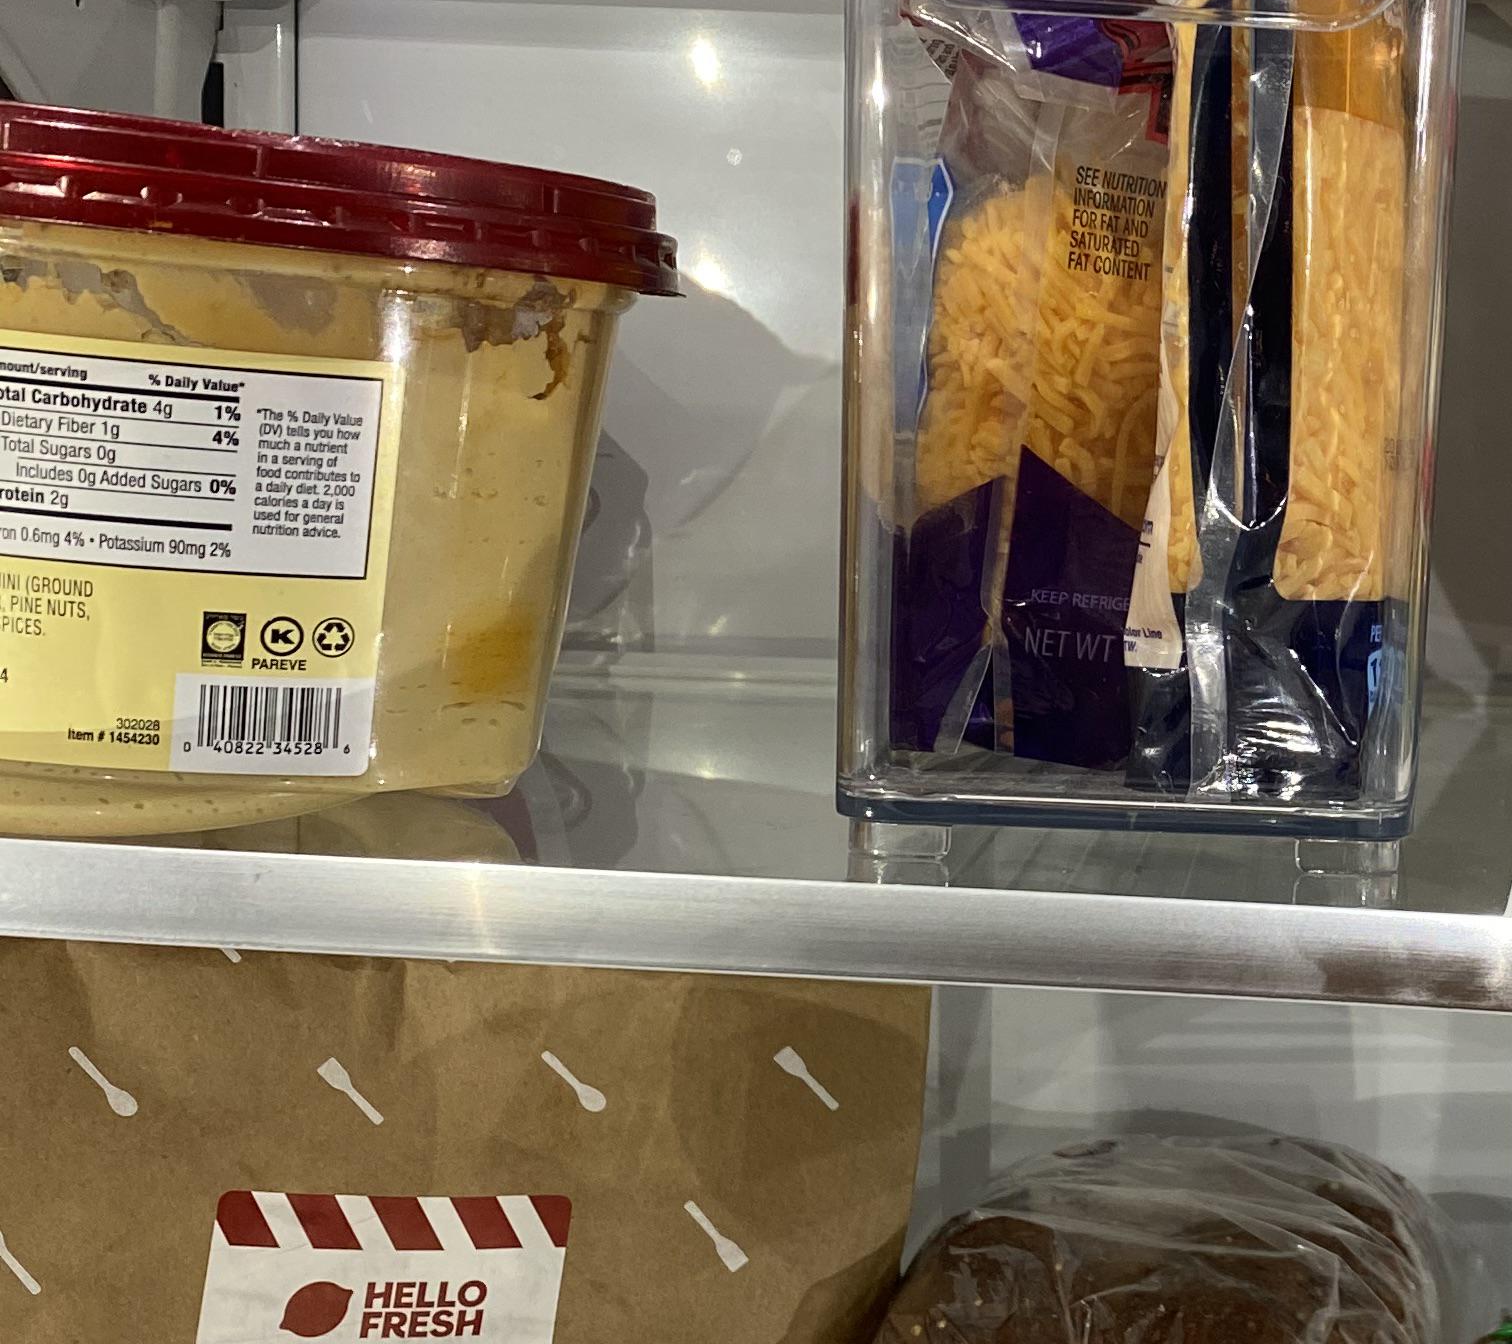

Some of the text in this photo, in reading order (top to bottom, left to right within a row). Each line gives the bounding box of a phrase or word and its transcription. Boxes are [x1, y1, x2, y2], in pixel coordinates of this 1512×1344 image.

[1075, 166, 1168, 199] SEE NUTRITION
[1073, 187, 1156, 218] INFORMATION
[1072, 208, 1149, 239] FOR FAT AND
[1070, 230, 1140, 258] SATURATED
[1068, 251, 1151, 282] FAT CONTENT
[148, 374, 161, 386] %
[165, 375, 198, 390] Daily
[32, 389, 147, 414] Carbohydrate
[153, 400, 173, 419] 4g
[214, 405, 241, 422] 1%
[287, 410, 298, 423] %
[303, 411, 331, 427] Daily
[333, 413, 363, 427] Value
[1, 411, 239, 446] Dietary Fiber 1g 4%
[259, 423, 361, 441] (DV) tells you how
[1, 435, 116, 464] Total Sugars 0g
[258, 439, 349, 454] much a nutrient
[257, 452, 338, 469] in a serving of
[16, 462, 236, 495] Includes 0g Added Sugars 0%
[256, 466, 361, 483] food contributes to
[255, 482, 262, 492] a
[266, 481, 293, 495] daily
[323, 484, 355, 498] 2,000
[50, 490, 69, 508] 2g
[254, 496, 344, 512] calories a day is
[253, 510, 344, 525] used for general
[252, 525, 341, 538] nutrition advice.
[20, 526, 60, 548] 0.6mg
[64, 531, 85, 547] 4%
[99, 533, 165, 553] Potassium
[169, 539, 205, 559] 90mg
[209, 542, 232, 558] 2%
[26, 575, 94, 597] (GROUND
[1031, 588, 1070, 606] KEEP
[11, 595, 90, 621] PINE NUTS,
[1025, 625, 1117, 663] NET WT
[251, 658, 307, 671] PAREVE
[116, 717, 160, 731] 302028
[68, 728, 94, 742] Item
[110, 731, 160, 745] 1454230
[213, 740, 264, 755] 40822
[273, 741, 323, 755] 34528
[344, 744, 350, 754] 6
[364, 1279, 488, 1310] HELLO
[358, 1309, 485, 1339] FRESH
